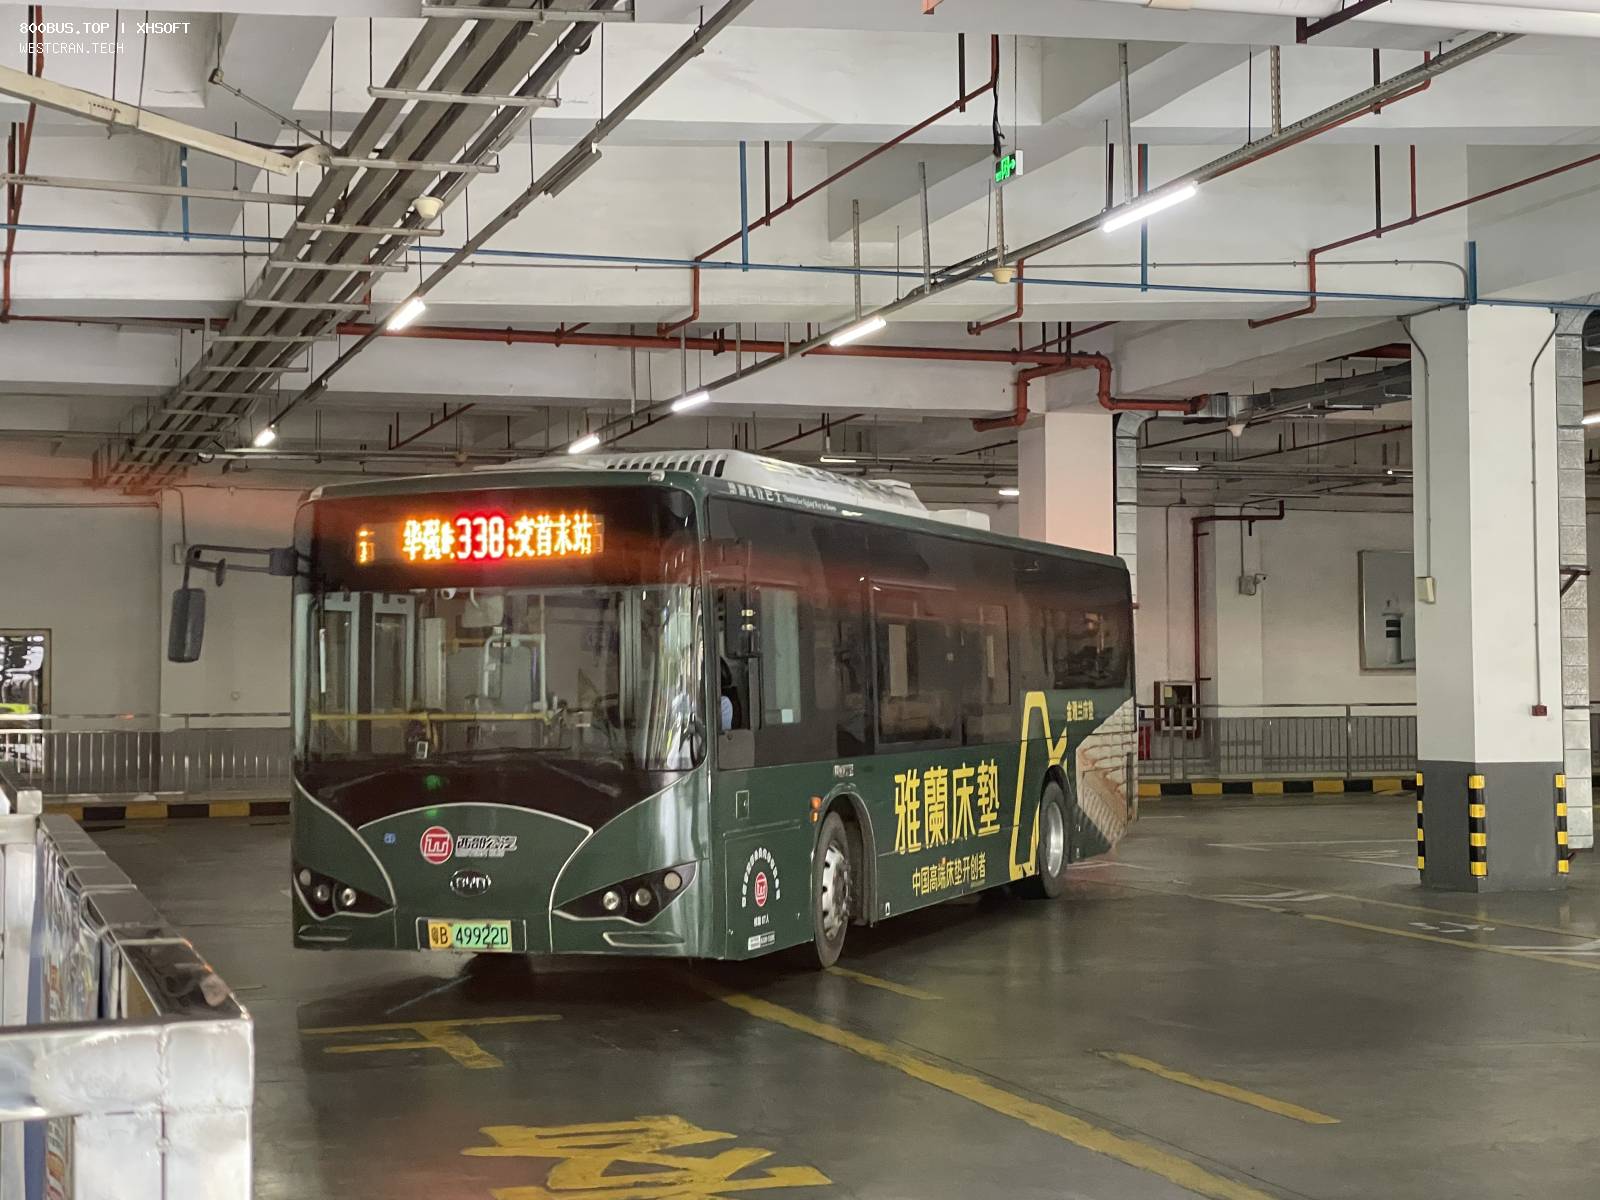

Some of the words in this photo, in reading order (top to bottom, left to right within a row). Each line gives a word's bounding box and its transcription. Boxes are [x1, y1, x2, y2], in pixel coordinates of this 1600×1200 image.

[455, 515, 505, 559] 338
[894, 758, 1001, 855] 雅蘭床墊
[912, 851, 986, 897] 中国高端床垫开创者
[455, 925, 509, 945] 49922D
